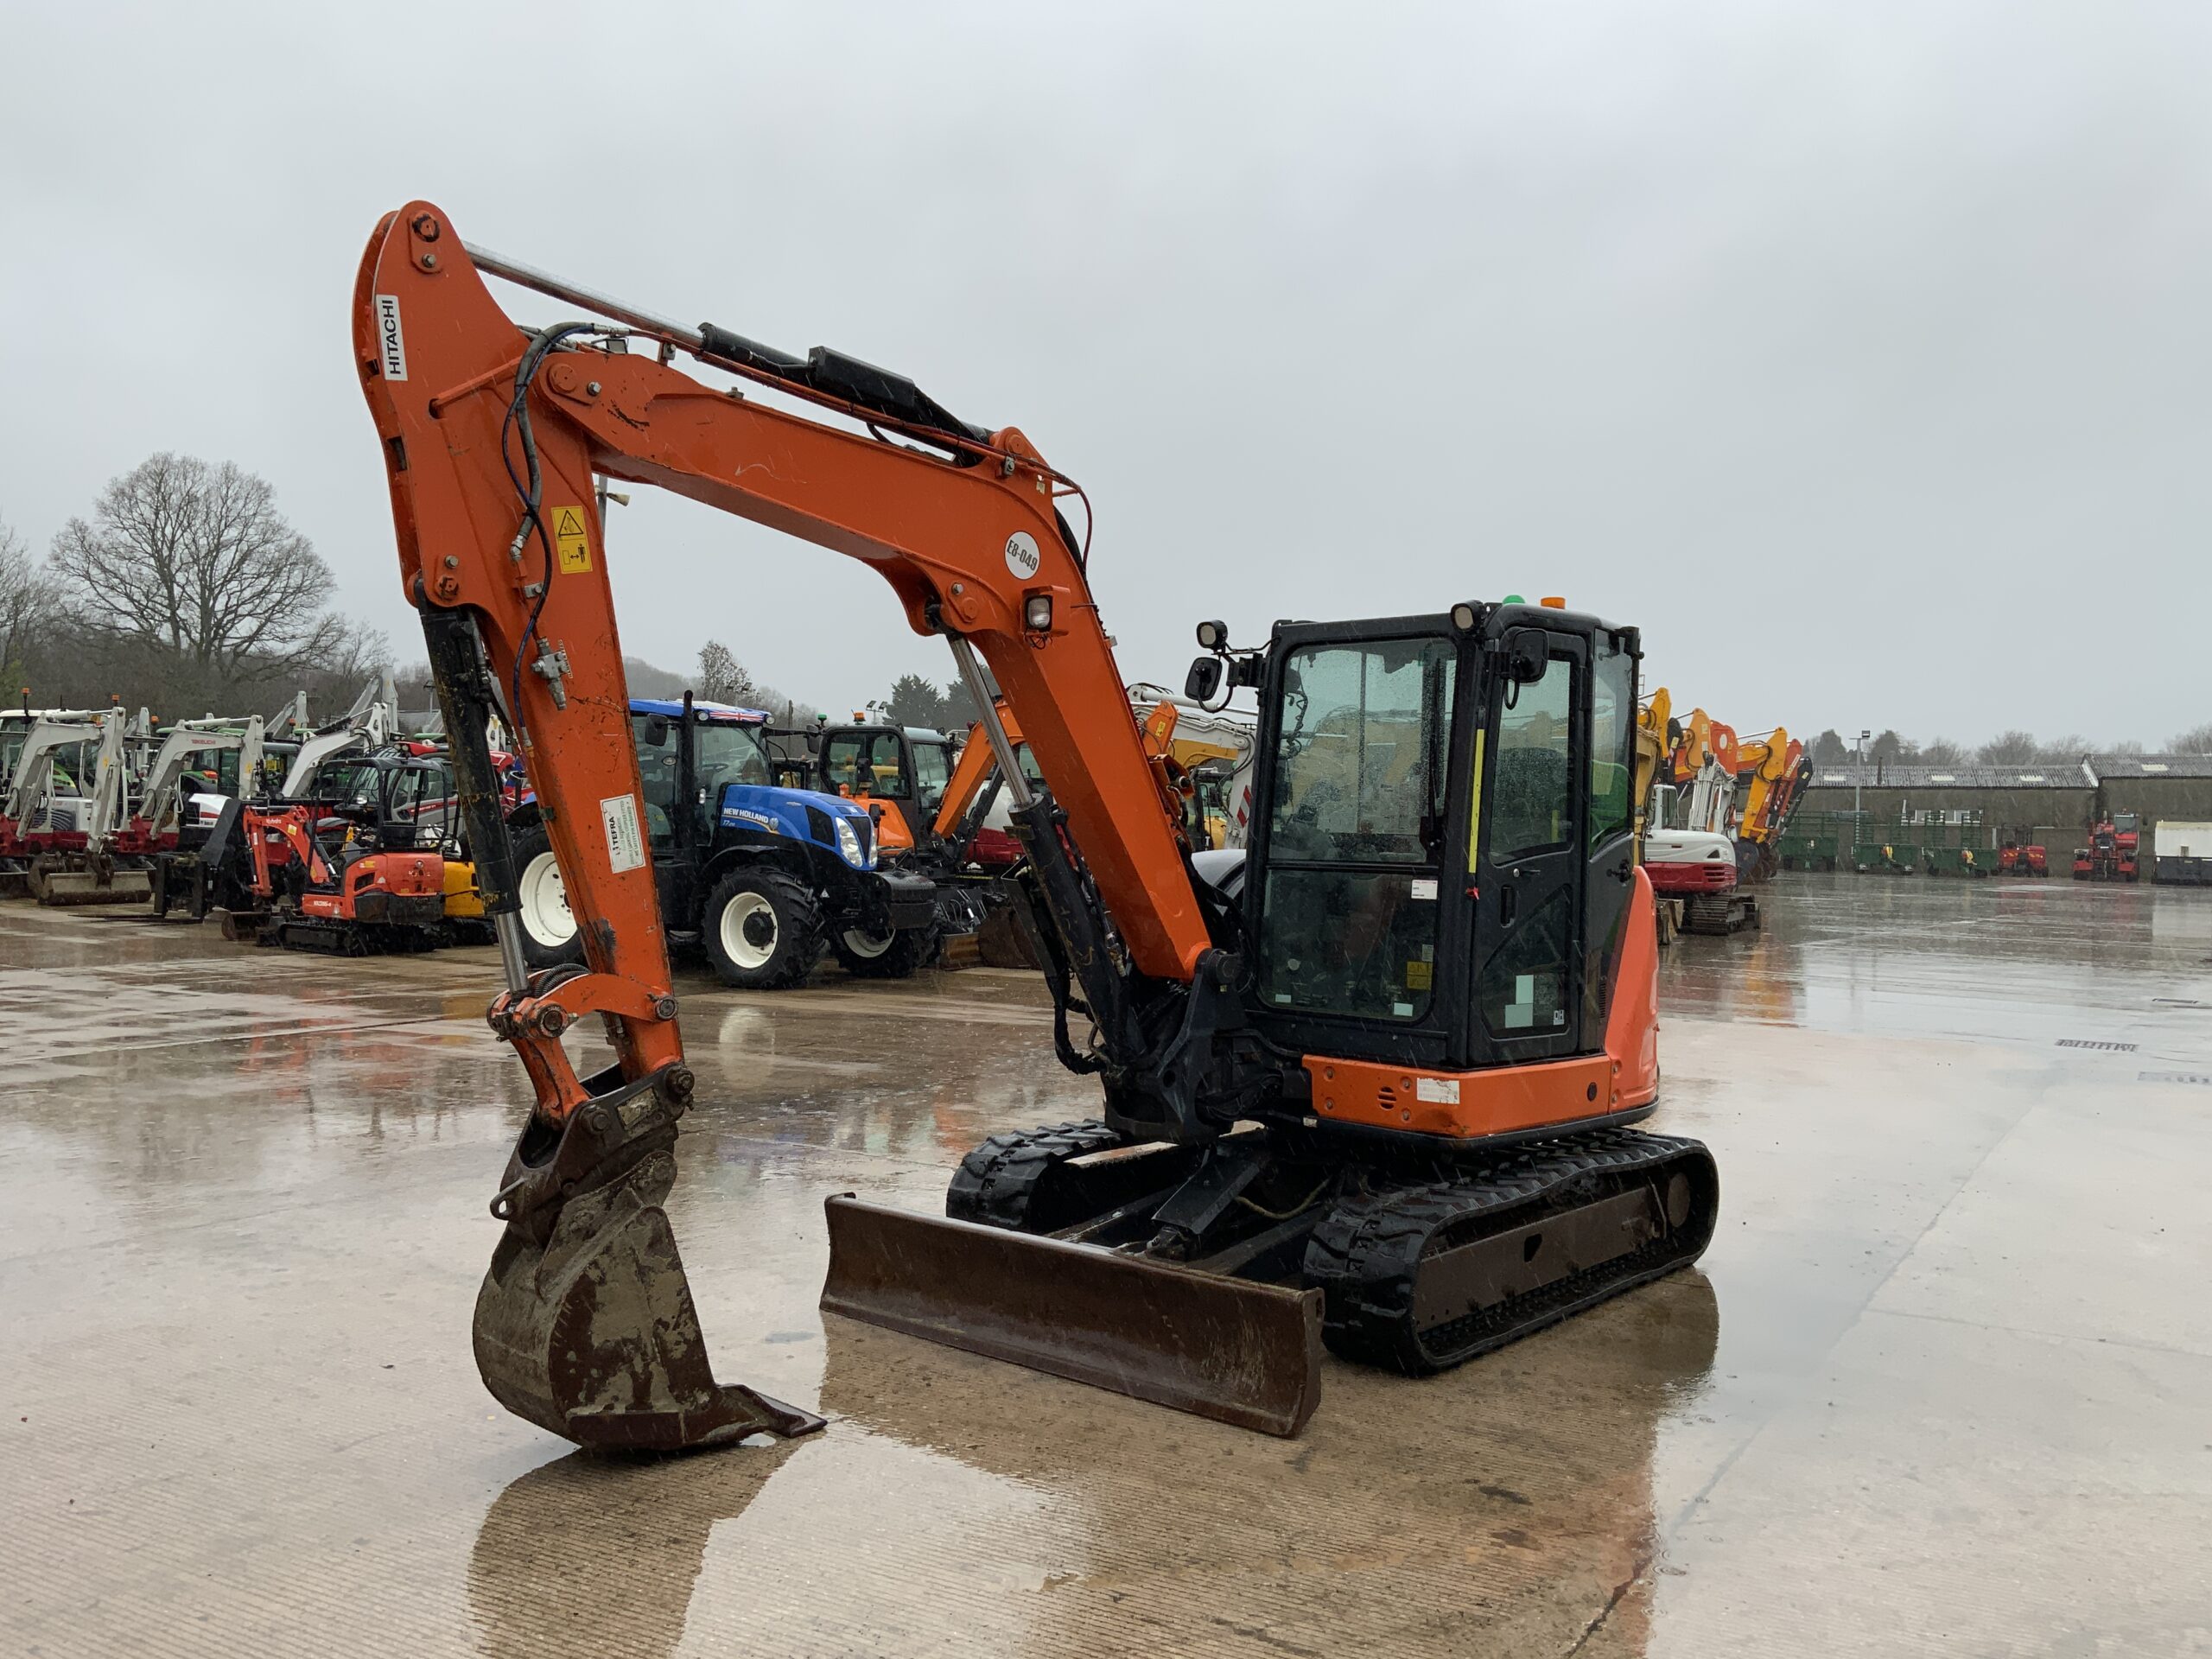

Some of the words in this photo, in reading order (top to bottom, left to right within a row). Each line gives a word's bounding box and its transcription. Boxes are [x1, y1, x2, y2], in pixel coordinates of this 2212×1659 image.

[382, 300, 401, 375] HITACHI
[1007, 539, 1038, 571] E8-049
[723, 807, 739, 816] NEW
[739, 809, 769, 823] HOLLAND
